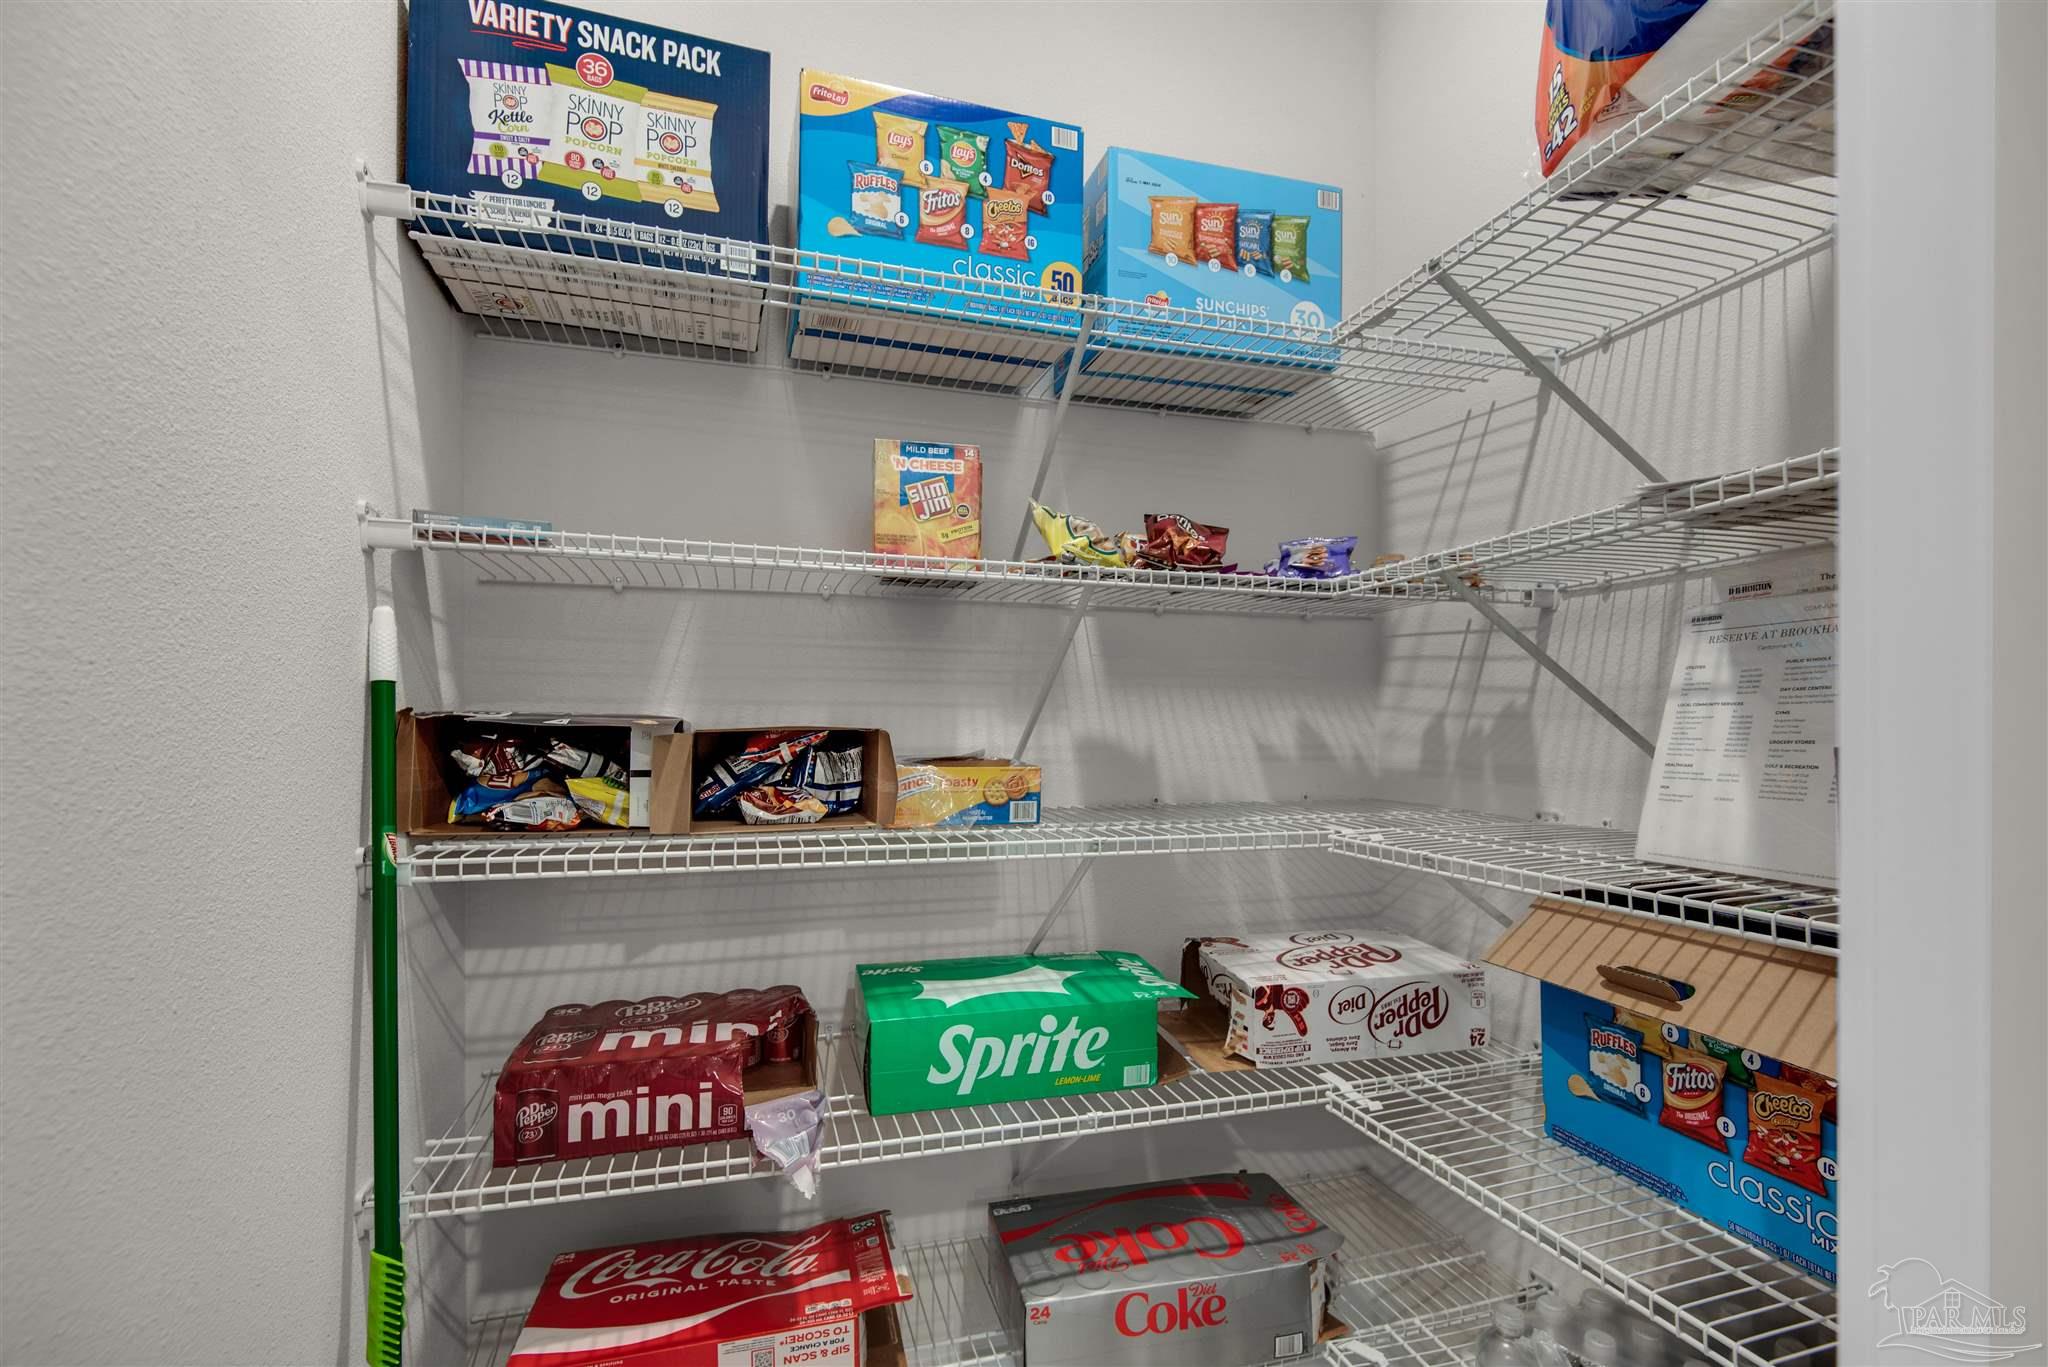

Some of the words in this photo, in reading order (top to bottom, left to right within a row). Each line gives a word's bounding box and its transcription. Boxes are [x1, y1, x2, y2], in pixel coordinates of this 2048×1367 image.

[468, 0, 573, 43] VARIETY
[577, 20, 657, 63] SNACK
[663, 39, 721, 77] PACK
[583, 58, 608, 77] 36
[493, 82, 527, 95] SKINNY
[493, 93, 528, 110] POP
[568, 93, 624, 121] SKINNY
[488, 109, 534, 126] Kettle
[647, 112, 697, 135] SKINNY
[566, 111, 624, 145] POP
[564, 135, 623, 156] POPCORN
[646, 128, 697, 157] POP
[646, 151, 698, 167] POPCORN
[923, 163, 930, 172] 6
[1010, 158, 1044, 177] Doritos
[855, 173, 898, 192] RUFFLES
[982, 175, 988, 183] 4
[586, 186, 598, 197] 12
[1044, 194, 1052, 202] 10
[668, 203, 680, 213] 12
[923, 190, 961, 214] Fritos
[988, 200, 1023, 218] Cheetos
[1200, 216, 1224, 232] Sun
[1239, 225, 1260, 237] Sun
[1274, 231, 1297, 244] Sun
[953, 256, 1037, 288] classic
[1051, 270, 1075, 293] 50
[1196, 297, 1268, 318] SUNCHIPS
[1294, 308, 1320, 328] 30
[928, 447, 950, 455] BEEF
[964, 449, 974, 457] 14
[909, 458, 962, 473] CHEESE
[1819, 573, 1837, 581] The
[1708, 631, 1759, 645] RESERVE
[1760, 630, 1778, 641] AT
[1293, 944, 1391, 967] Pepper
[1337, 992, 1366, 1015] Diet
[1374, 985, 1440, 1030] Pepper
[1393, 1011, 1423, 1038] Dr
[1667, 1027, 1673, 1038] 6
[1469, 1032, 1485, 1046] 24
[1591, 1029, 1637, 1057] RUFFLES
[926, 1014, 1110, 1096] Sprite
[1748, 1054, 1754, 1066] 4
[1055, 1074, 1101, 1086] LEMON-LIME
[1666, 1063, 1715, 1092] Fritos
[569, 1093, 583, 1101] mini
[597, 1092, 615, 1100] mega
[616, 1089, 634, 1098] taste.
[1603, 1083, 1627, 1099] ORIGINAL
[1640, 1088, 1646, 1098] 6
[529, 1102, 546, 1112] Dr
[568, 1082, 713, 1143] mini
[722, 1106, 733, 1116] 90
[1755, 1092, 1812, 1119] Cheetos
[519, 1105, 556, 1128] Pepper
[777, 1108, 796, 1123] 30
[524, 1130, 535, 1140] 23
[1722, 1122, 1729, 1132] 8
[1823, 1162, 1836, 1176] 16
[1708, 1160, 1839, 1240] classic
[1053, 1216, 1244, 1266] Coke
[559, 1230, 831, 1299] Coca-Cola
[1078, 1257, 1130, 1275] Diet
[609, 1283, 709, 1304] ORIGINAL
[717, 1278, 777, 1288] TASTE
[1188, 1280, 1217, 1297] Diet
[1029, 1305, 1051, 1320] 24
[1114, 1287, 1227, 1338] Coke
[833, 1325, 850, 1336] TO
[790, 1341, 821, 1353] CHANCE
[819, 1348, 829, 1357] &
[831, 1343, 850, 1356] SIP
[783, 1349, 815, 1365] SCAN
